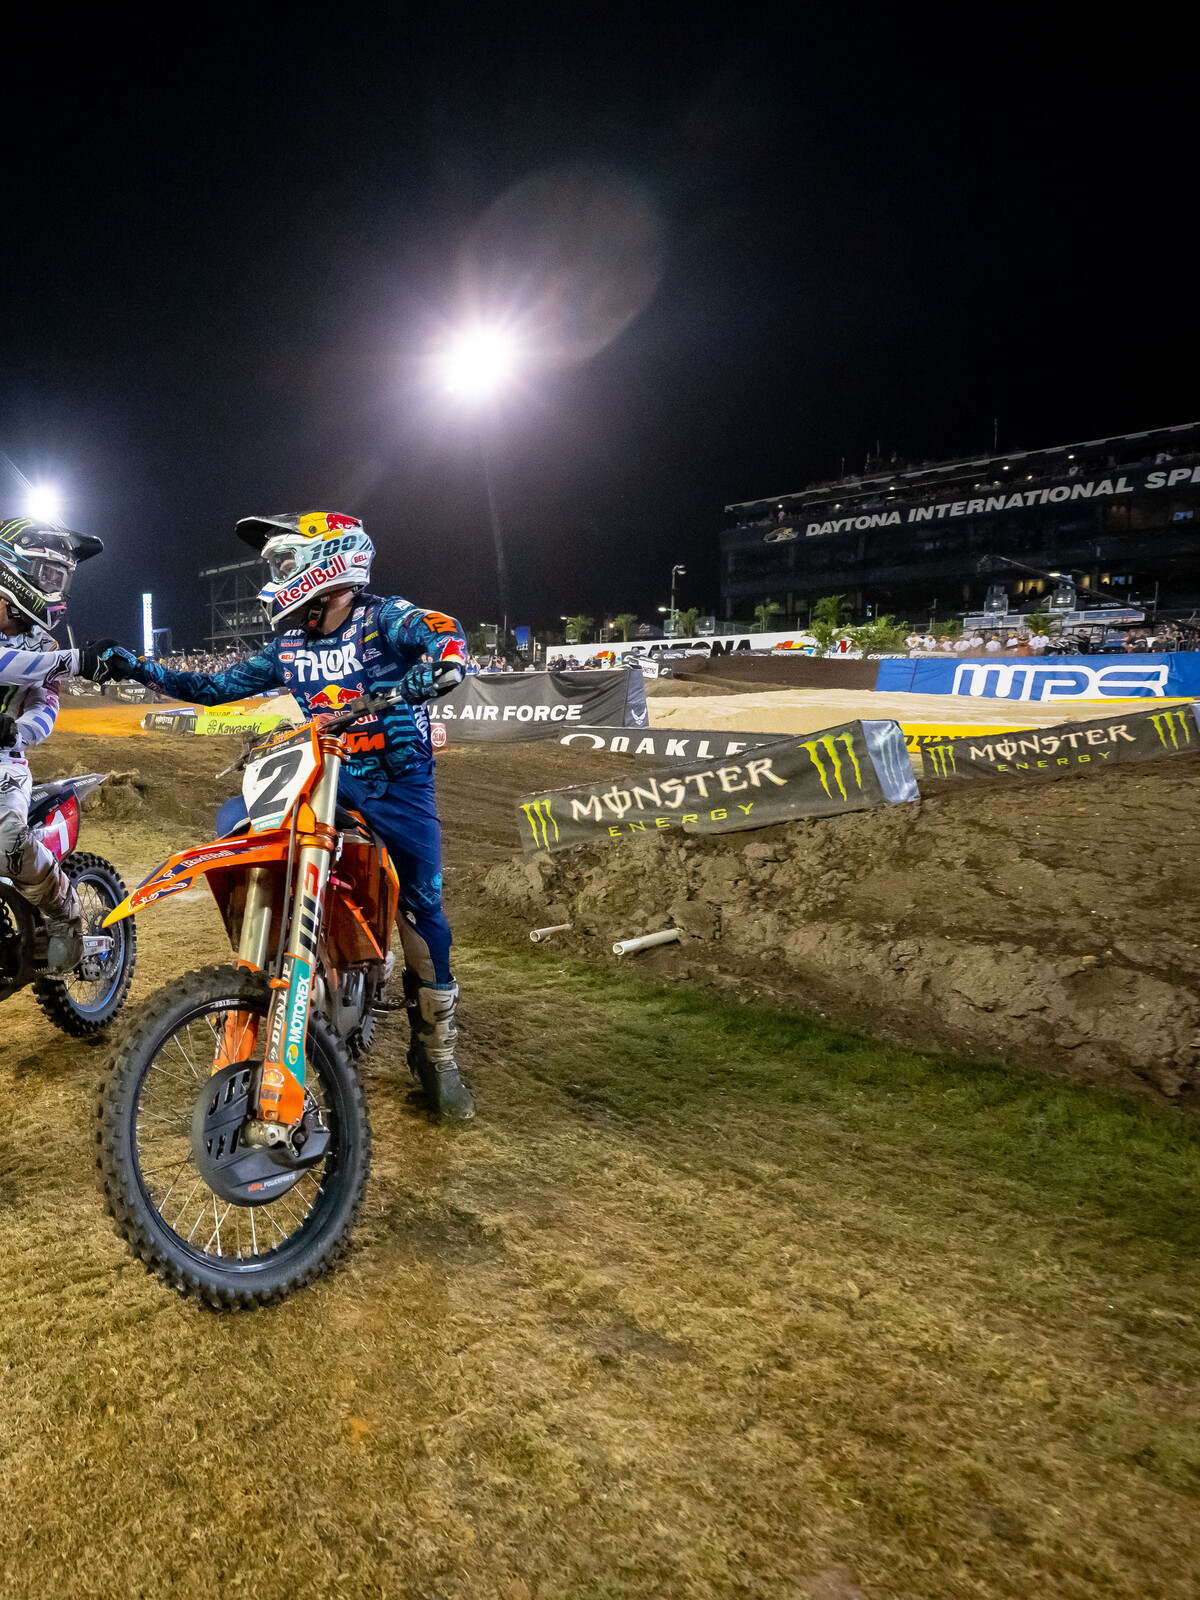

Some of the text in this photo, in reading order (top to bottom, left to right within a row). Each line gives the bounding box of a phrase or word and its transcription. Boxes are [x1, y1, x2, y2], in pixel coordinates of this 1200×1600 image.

[805, 511, 901, 537] DAYTONA
[907, 477, 1134, 523] INTERNATIONAL
[353, 555, 368, 564] BELL
[1, 570, 35, 600] MONSTER
[276, 555, 347, 607] Red Bull
[294, 641, 364, 683] THOR
[218, 722, 262, 734] Kawasaki
[460, 705, 497, 720] AIR
[503, 704, 583, 721] FORCE
[609, 736, 767, 758] OAKLE
[968, 724, 1136, 762] MONSTER
[997, 750, 1111, 772] ENERGY
[249, 749, 303, 820] 2
[569, 757, 788, 822] MONSTER
[608, 802, 754, 837] ENERGY
[271, 962, 294, 1047] DUNLP
[287, 976, 312, 1045] MOTOREX
